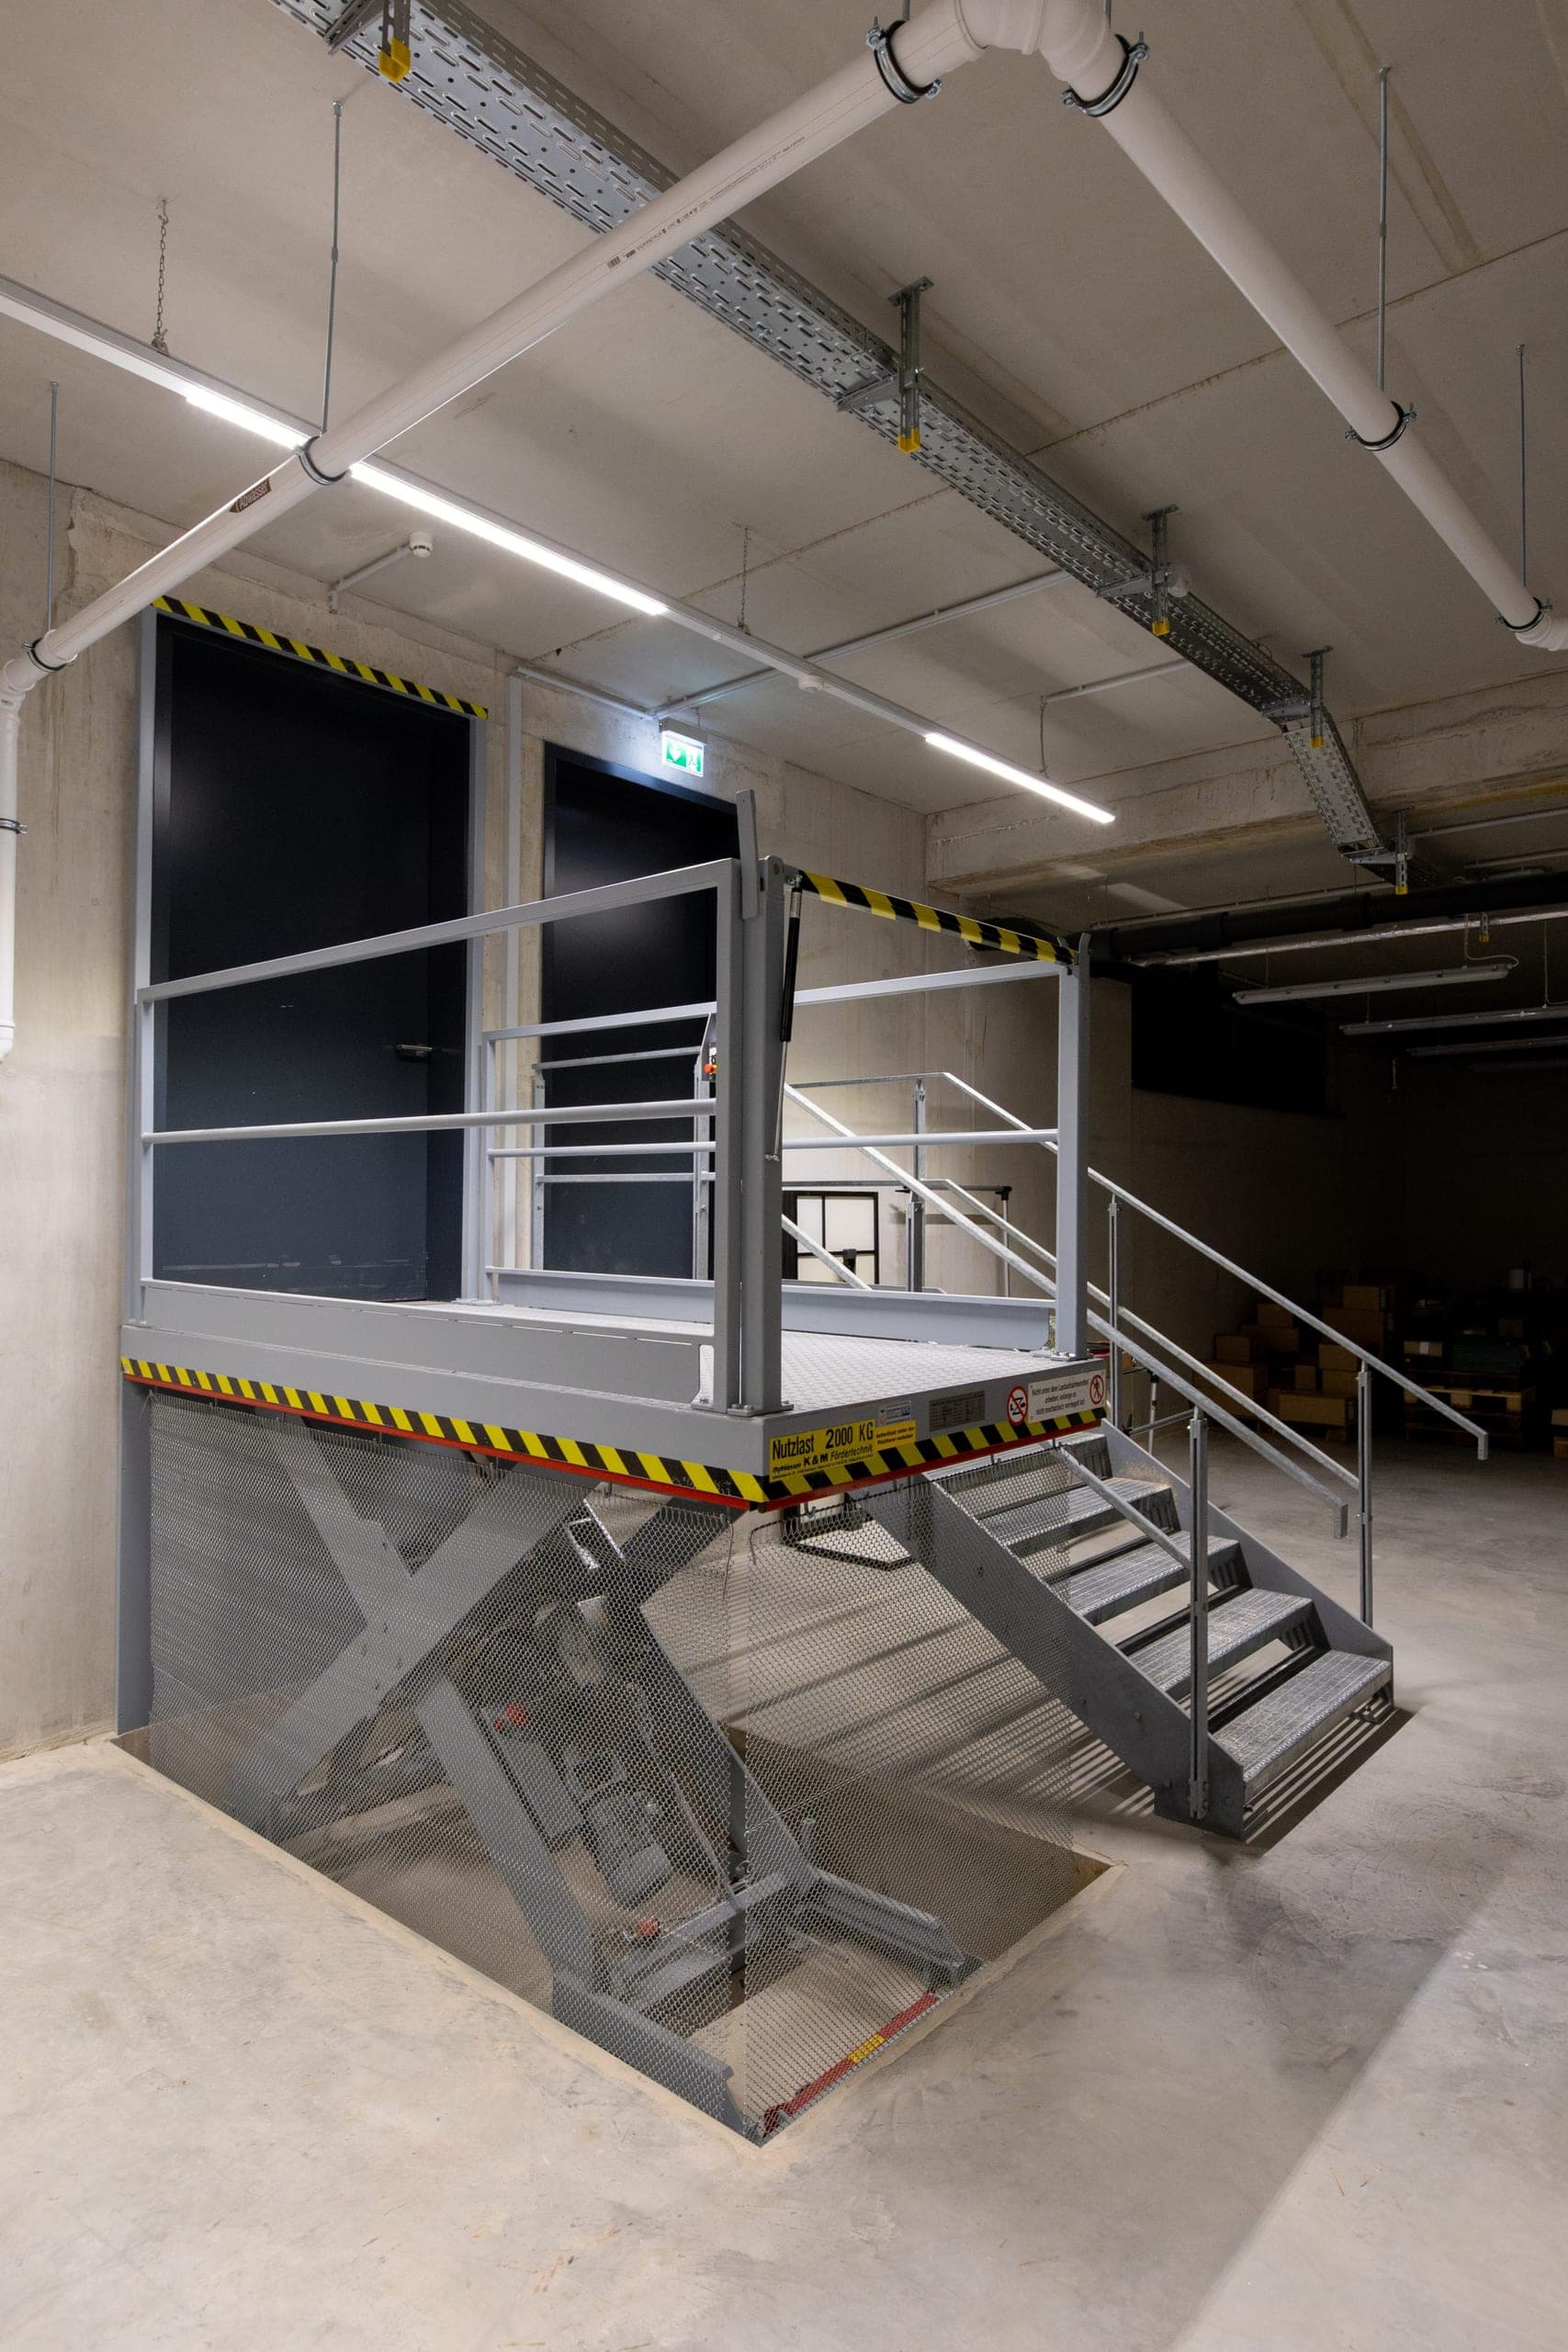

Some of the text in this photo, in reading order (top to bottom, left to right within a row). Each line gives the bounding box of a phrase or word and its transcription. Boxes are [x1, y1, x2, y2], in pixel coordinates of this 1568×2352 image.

[773, 1421, 874, 1461] Nutzlast 2000 KG
[803, 1458, 810, 1467] K
[811, 1455, 818, 1464] &
[819, 1453, 829, 1464] M
[829, 1445, 874, 1461] Fördertechnik
